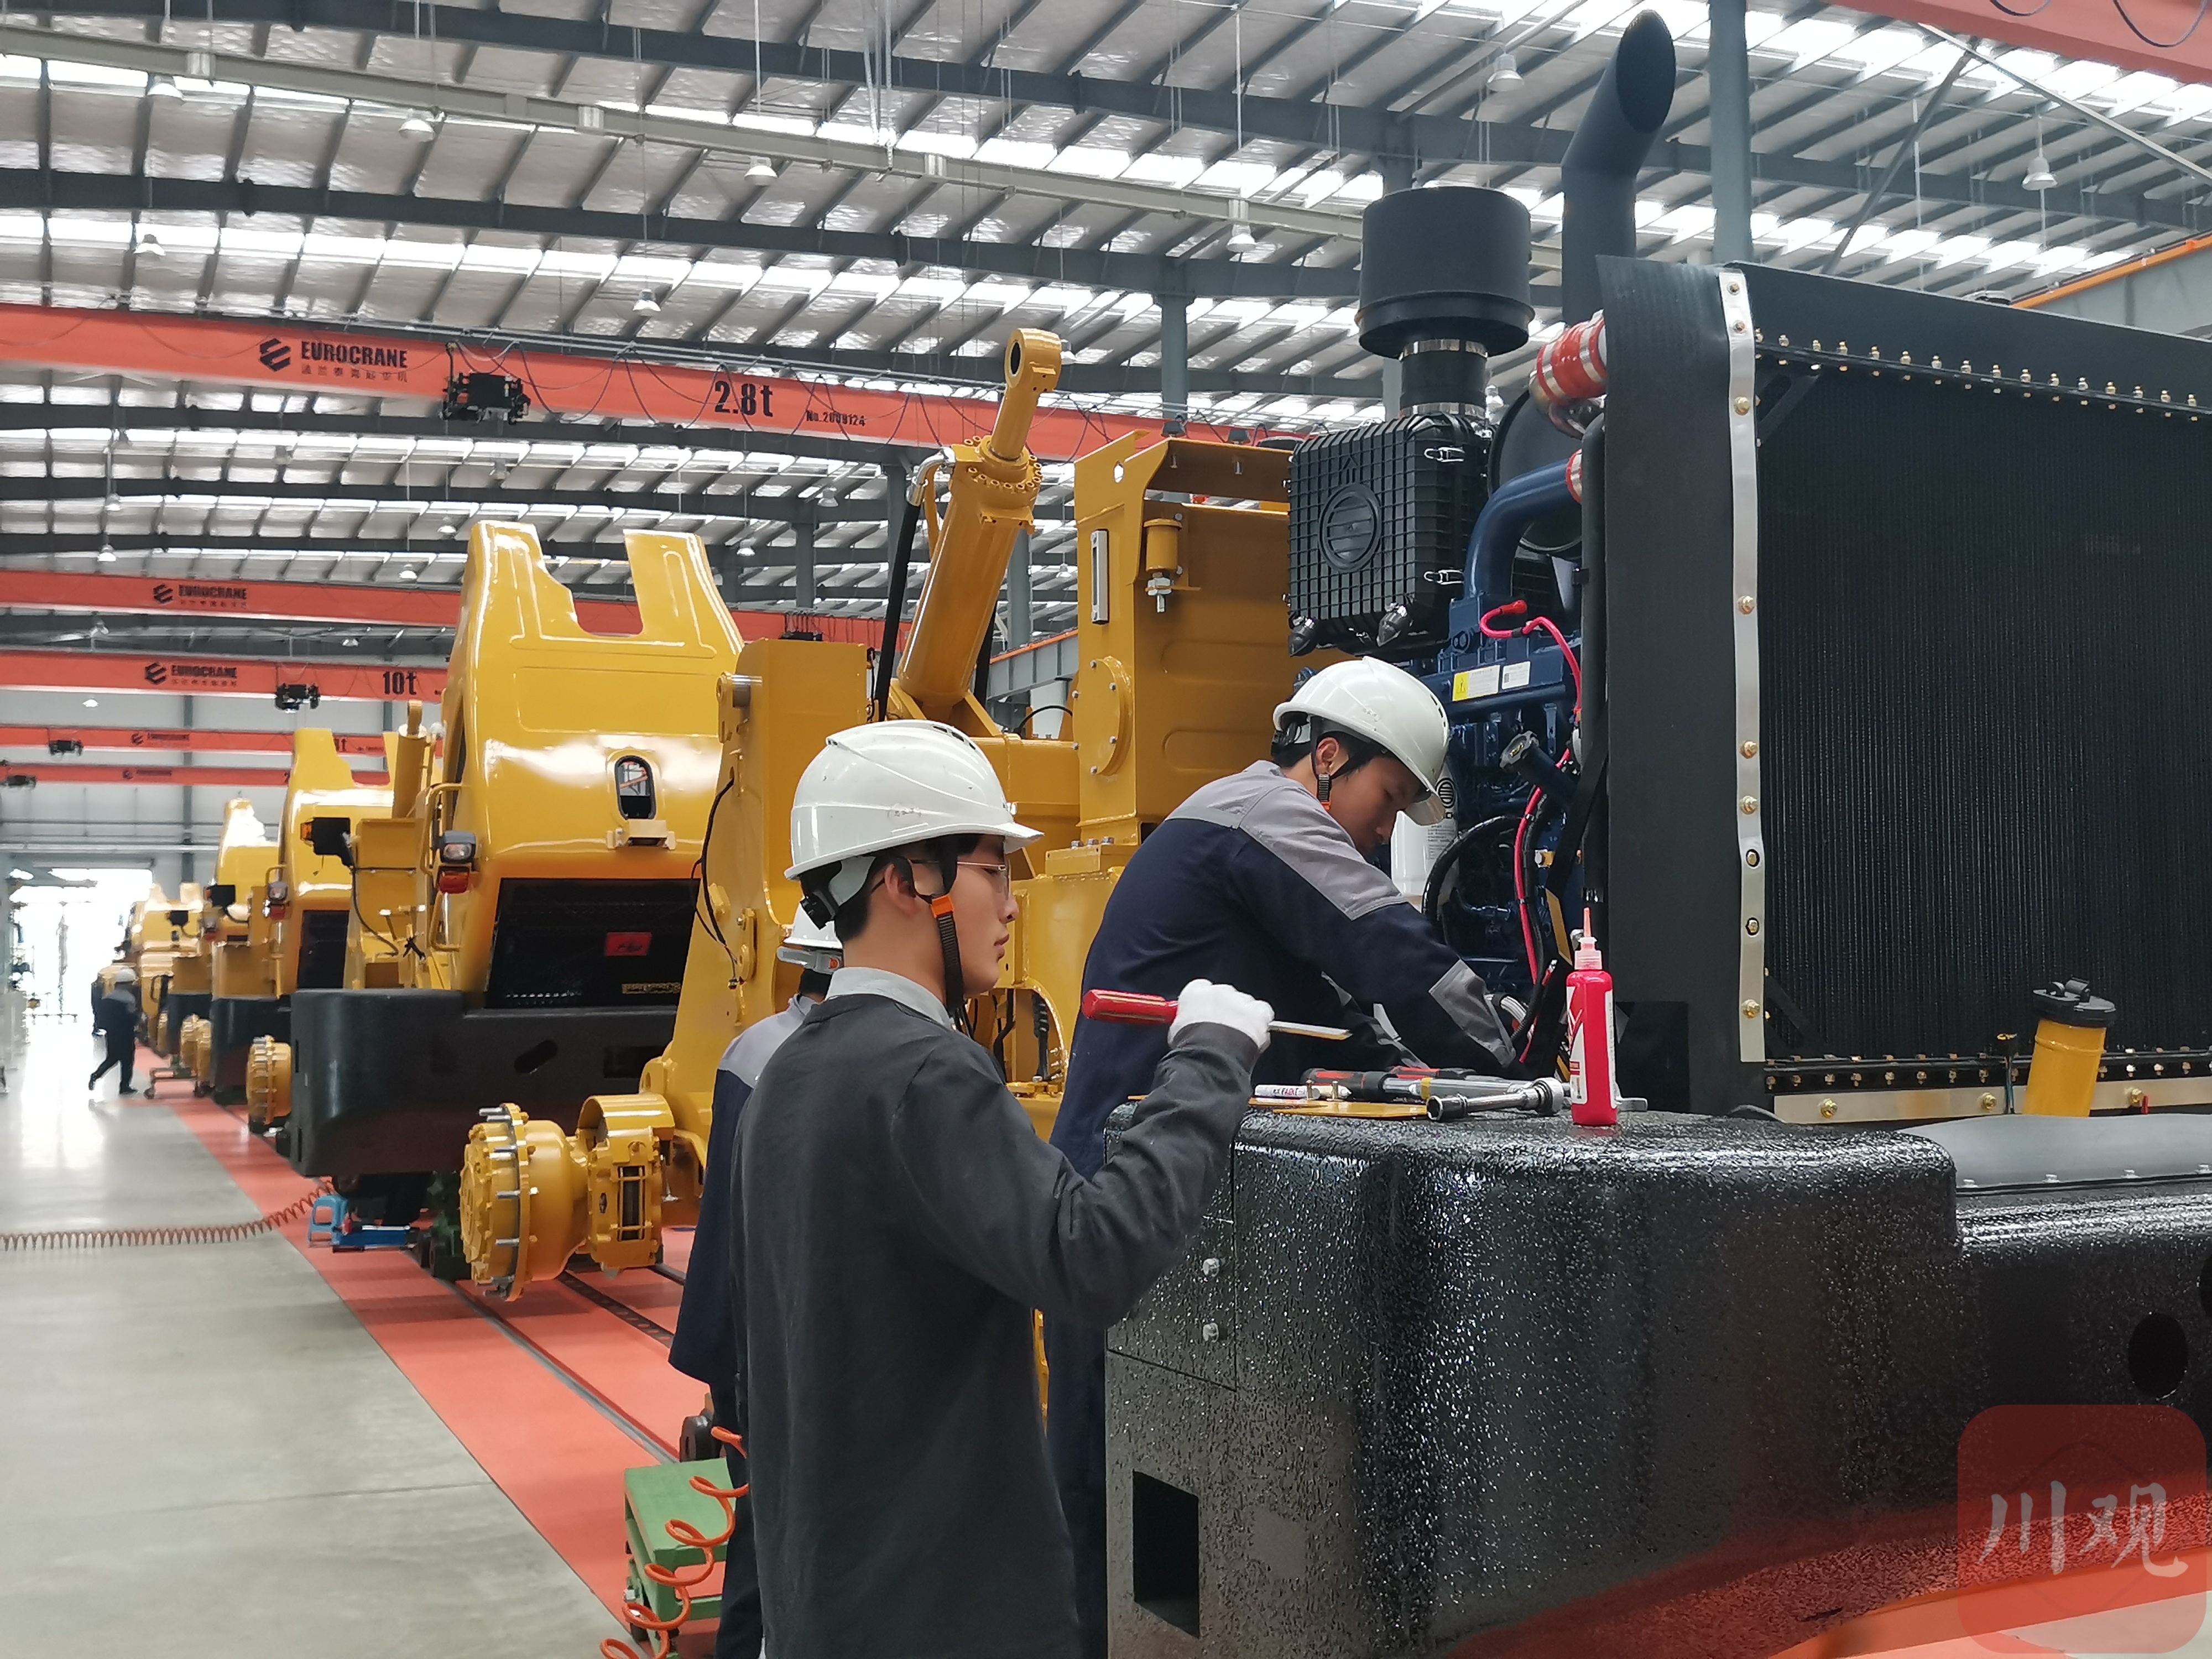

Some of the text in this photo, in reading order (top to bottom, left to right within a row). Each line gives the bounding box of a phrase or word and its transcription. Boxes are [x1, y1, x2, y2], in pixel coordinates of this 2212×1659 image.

[301, 340, 408, 368] EUROCRANE
[714, 380, 773, 417] 2.8t
[383, 671, 417, 695] 10t
